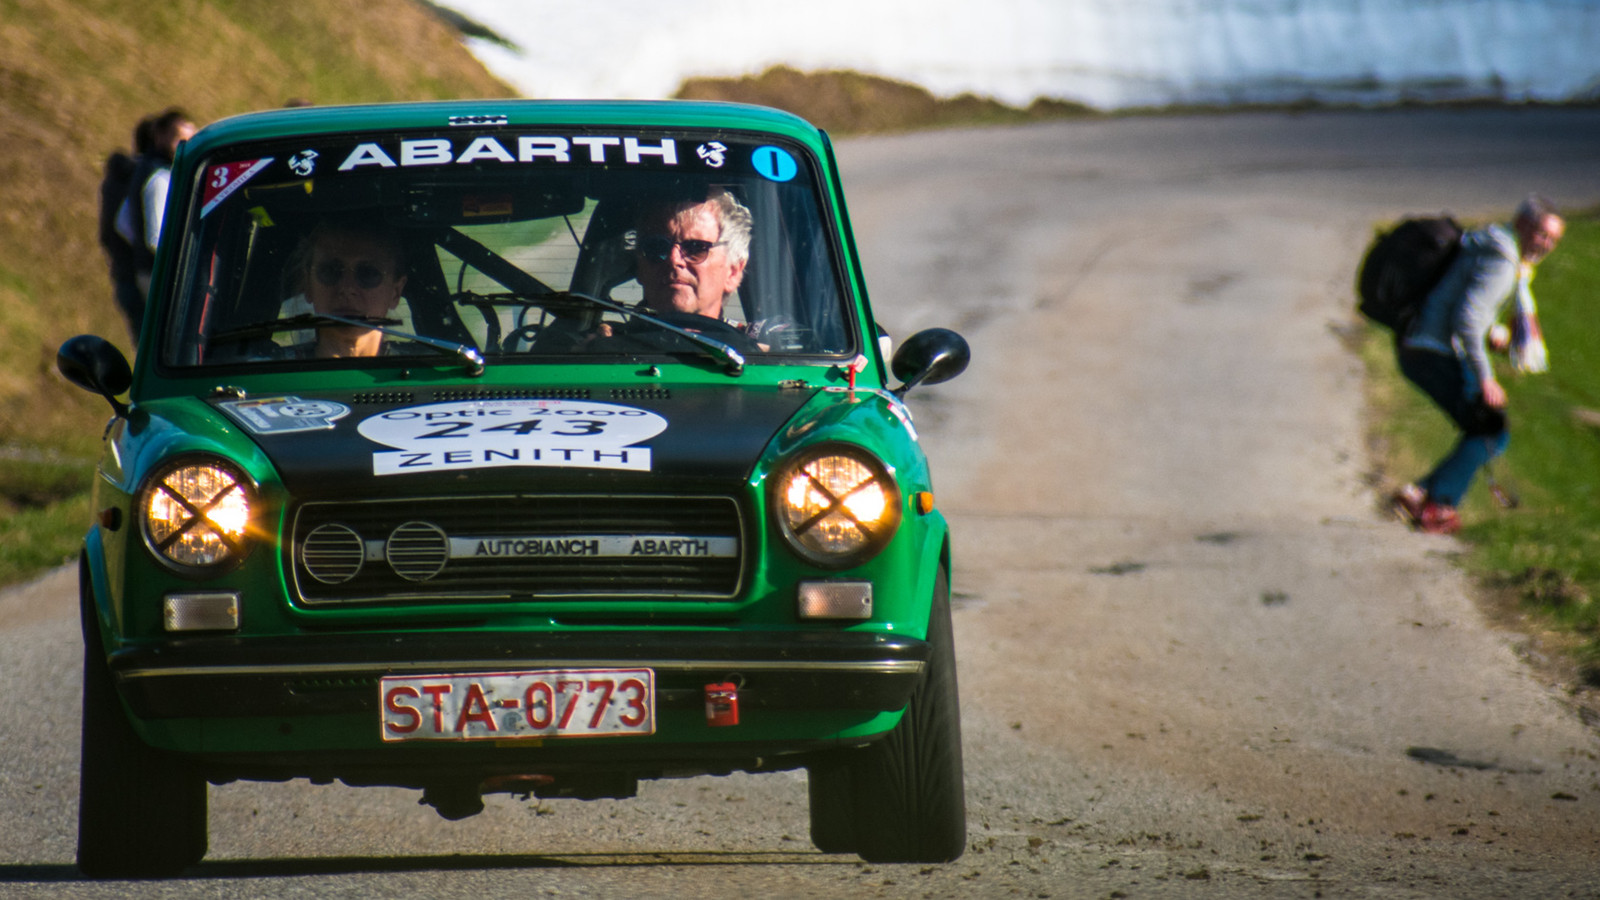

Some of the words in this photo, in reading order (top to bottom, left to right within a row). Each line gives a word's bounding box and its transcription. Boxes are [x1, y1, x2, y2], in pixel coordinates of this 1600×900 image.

[338, 136, 678, 171] ABARTH
[211, 167, 229, 188] 3
[381, 408, 512, 421] Optic
[528, 408, 648, 418] 2000
[414, 420, 607, 440] 243
[399, 449, 630, 468] ZENITH
[475, 539, 599, 556] AUTOBIANCHI
[630, 540, 709, 556] ABARTH
[386, 678, 648, 733] STA-0773
